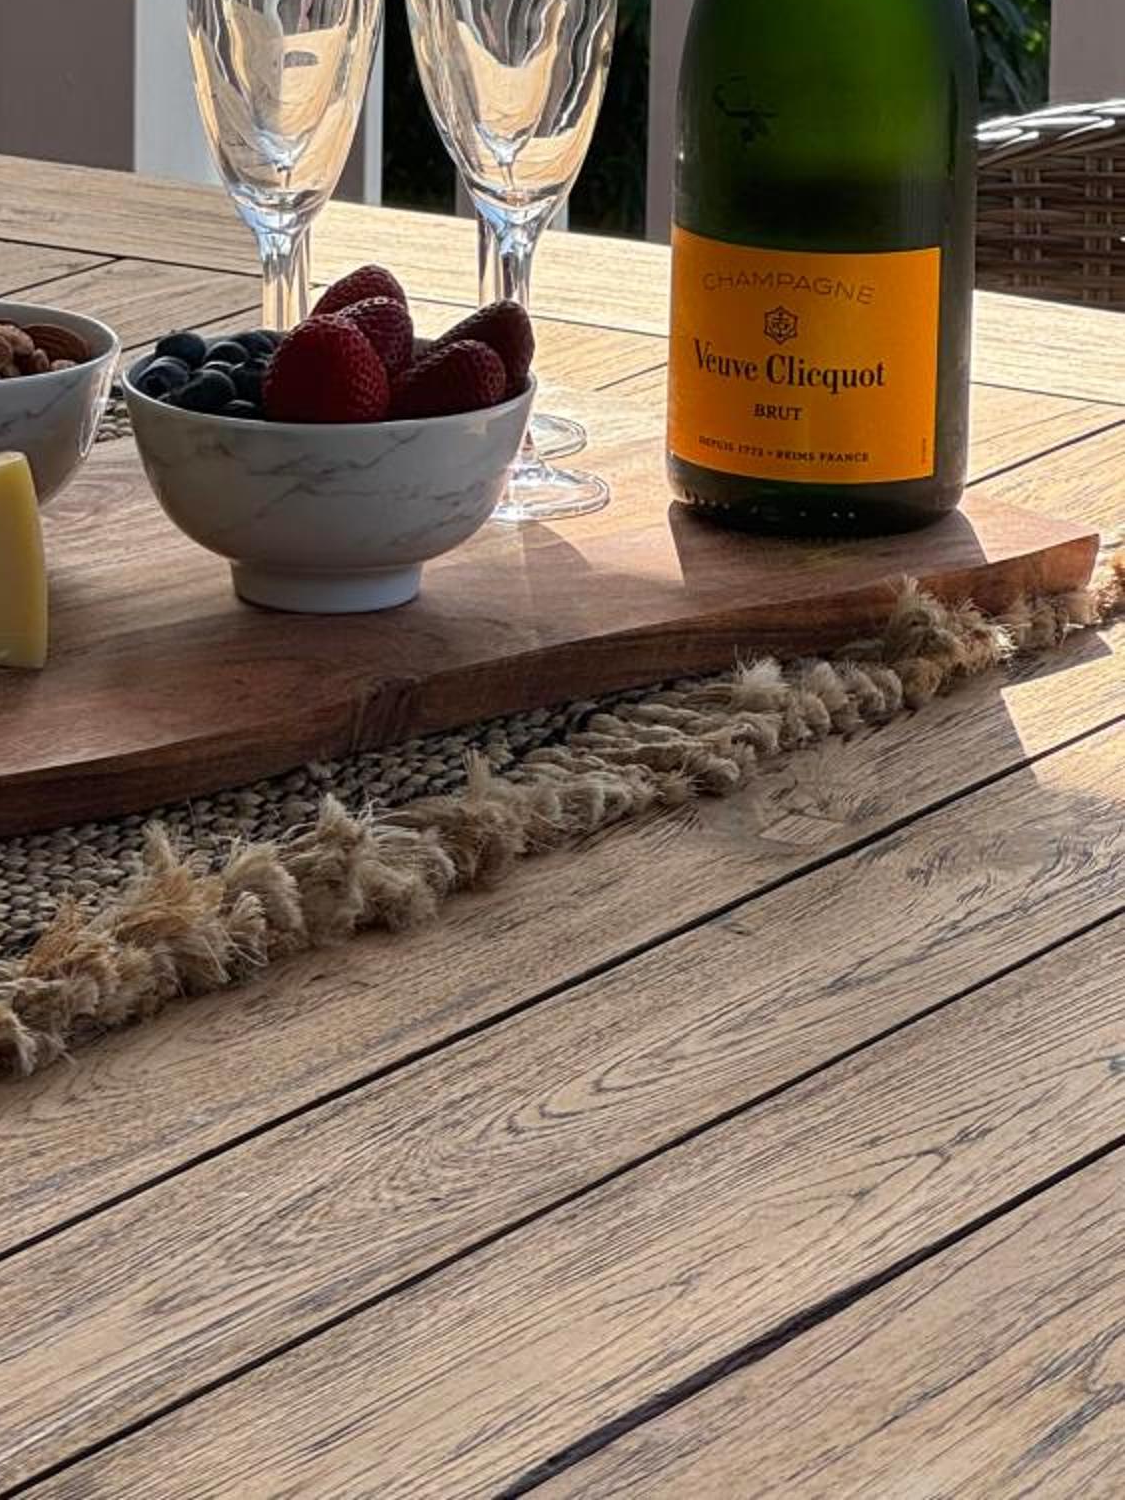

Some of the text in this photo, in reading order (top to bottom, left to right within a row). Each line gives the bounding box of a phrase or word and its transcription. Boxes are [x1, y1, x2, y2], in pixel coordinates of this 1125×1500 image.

[703, 272, 876, 304] CHAMPAGNE
[694, 338, 885, 395] Veuve Clicquot
[754, 403, 803, 420] BRUT
[820, 451, 869, 463] FRANCE
